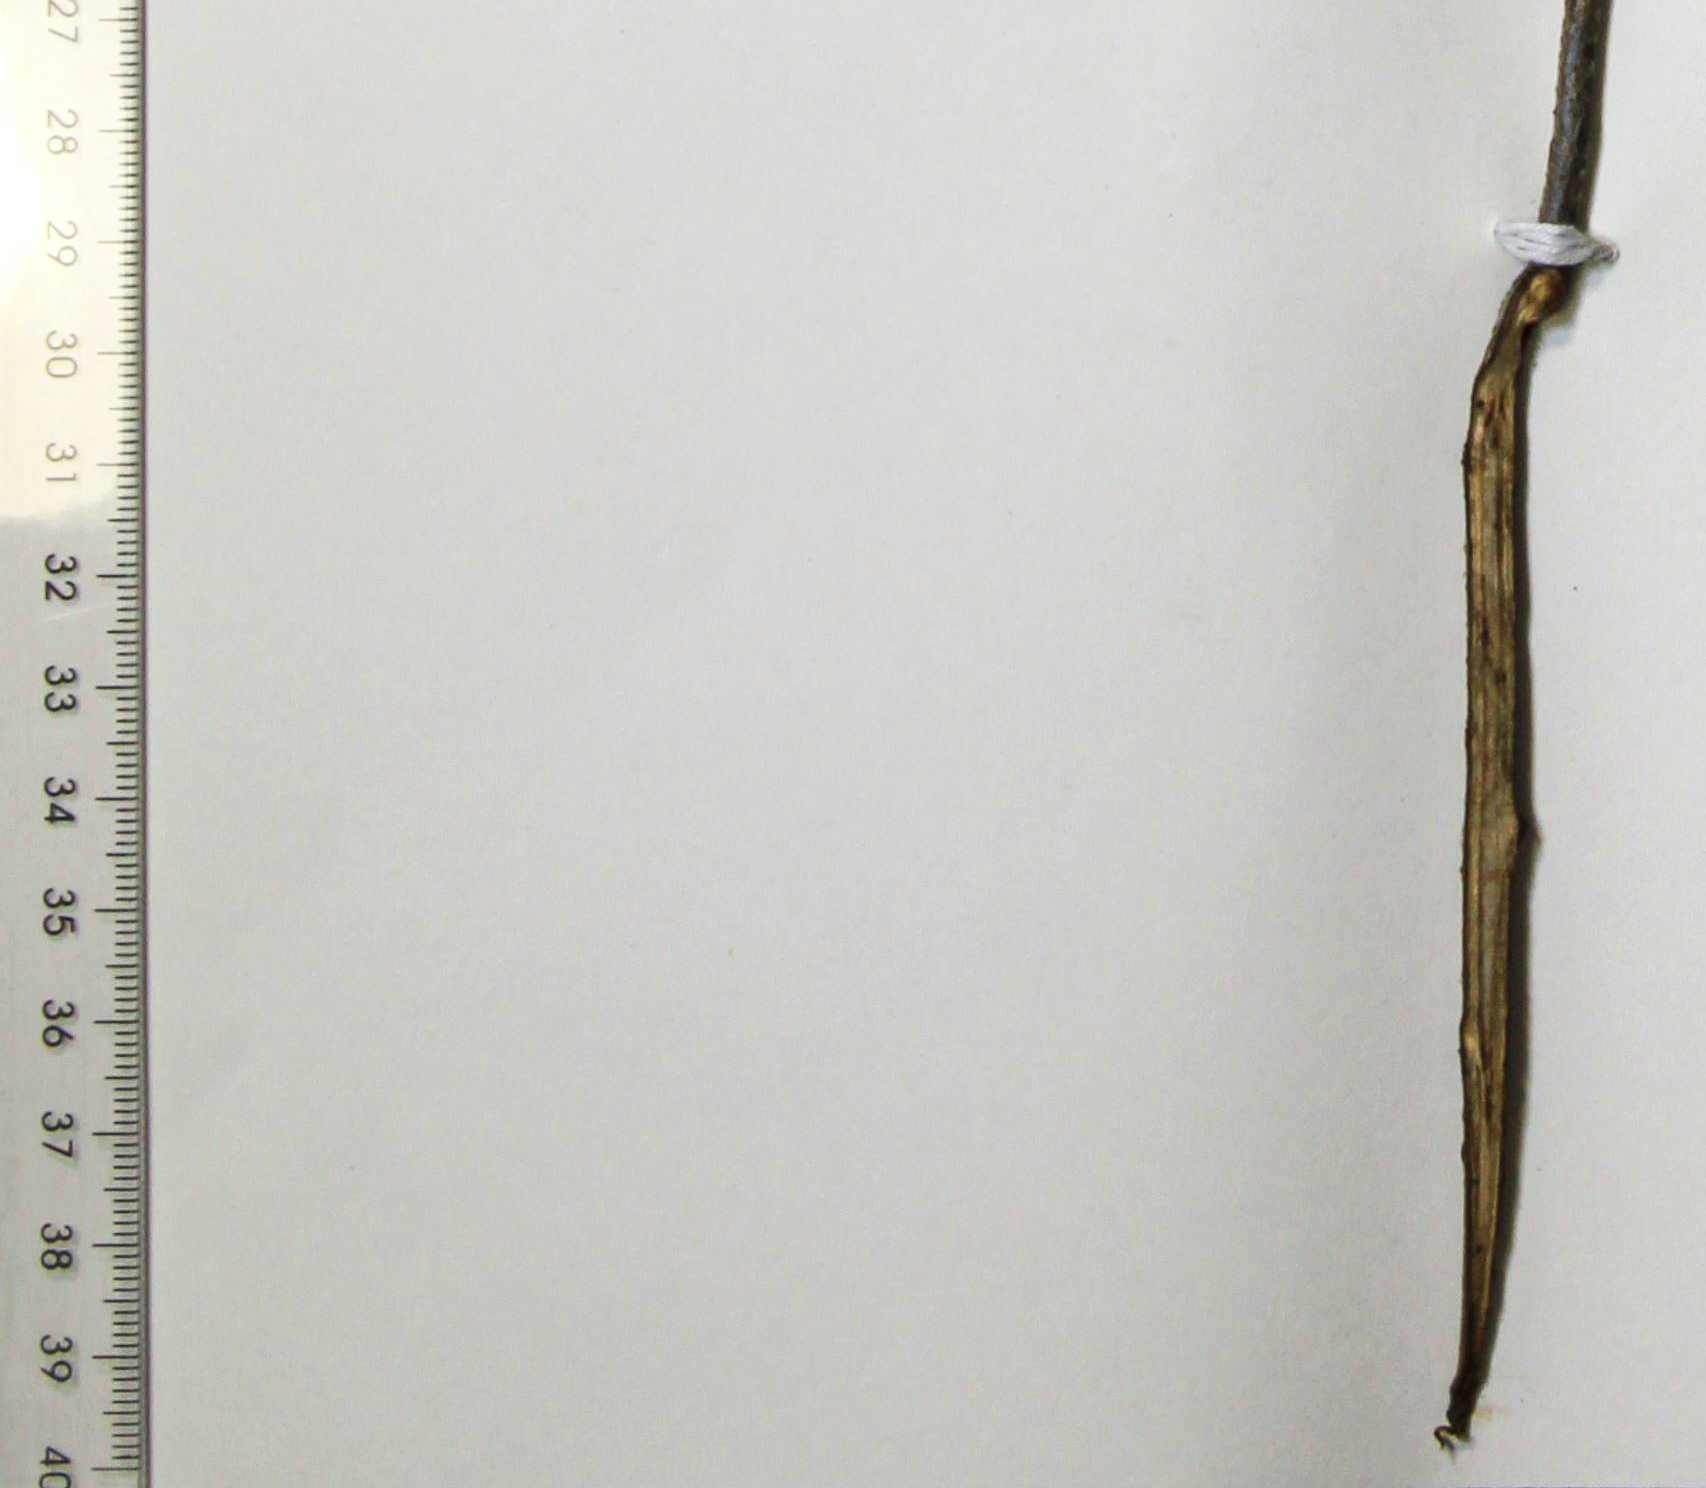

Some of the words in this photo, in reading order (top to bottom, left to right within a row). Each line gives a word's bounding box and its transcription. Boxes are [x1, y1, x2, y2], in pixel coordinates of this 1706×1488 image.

[46, 108, 79, 156] 28
[46, 220, 79, 267] 29
[45, 330, 79, 379] 30
[45, 442, 78, 482] 31
[44, 553, 79, 602] 32
[43, 665, 79, 714] 33
[43, 776, 78, 825] 34
[42, 887, 78, 937] 35
[41, 999, 77, 1049] 36
[41, 1111, 75, 1159] 37
[40, 1222, 75, 1271] 38
[39, 1334, 74, 1384] 39
